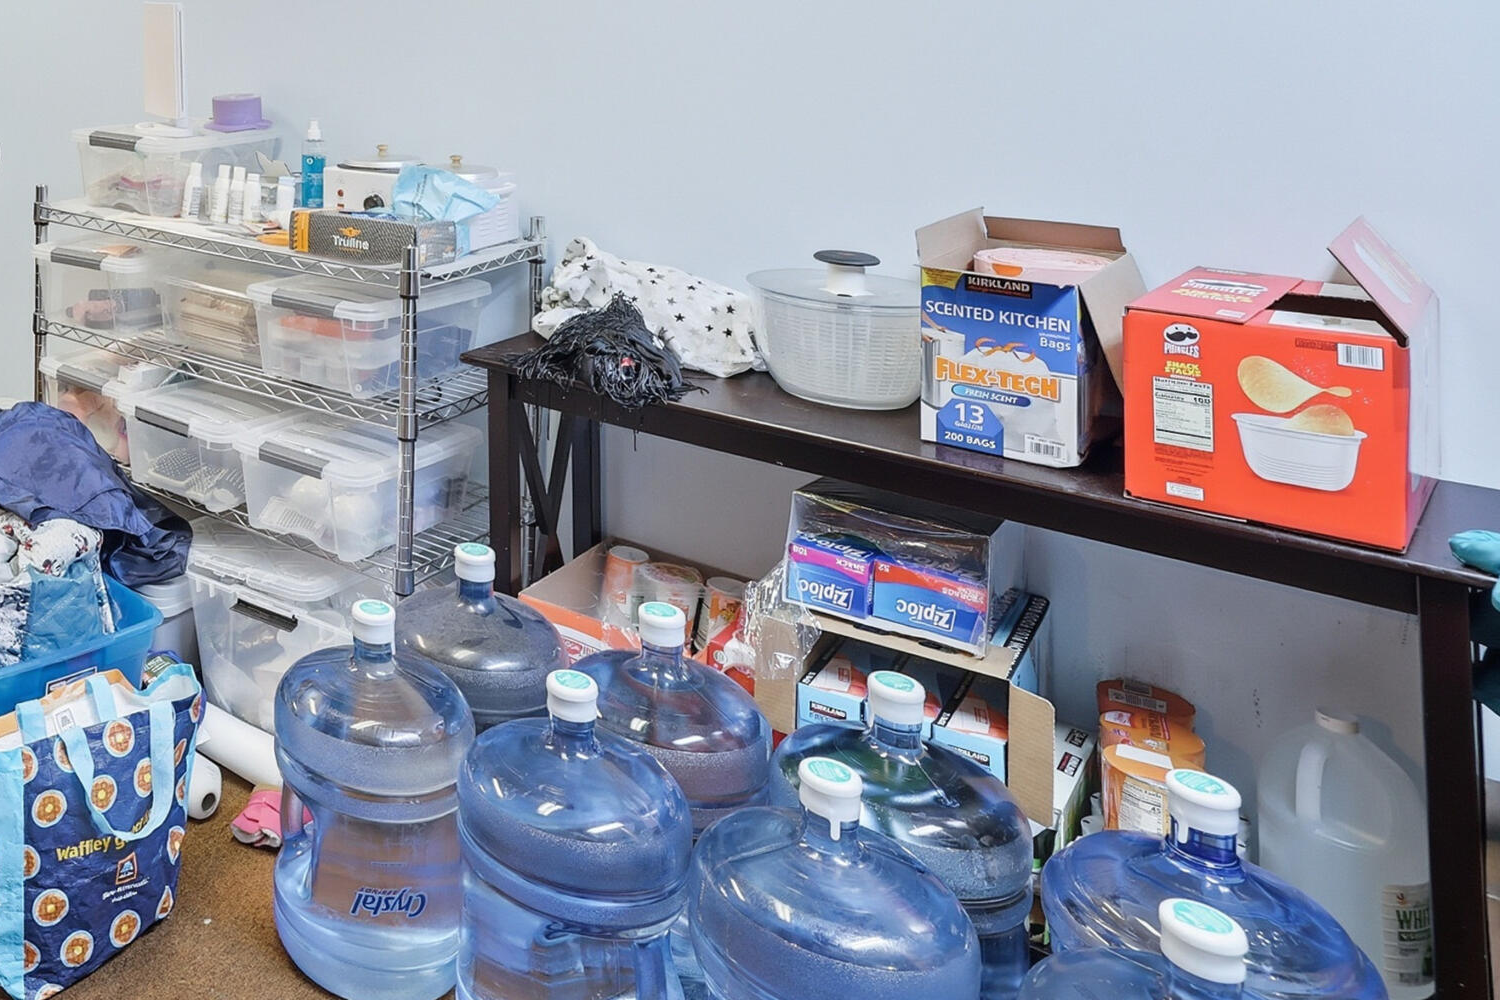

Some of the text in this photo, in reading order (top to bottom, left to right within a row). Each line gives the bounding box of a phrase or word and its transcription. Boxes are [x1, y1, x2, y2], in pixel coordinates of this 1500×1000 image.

[967, 276, 1031, 292] KIRKLAND
[924, 299, 1071, 333] SCENTED KITCHEN
[1039, 337, 1072, 352] Bags
[1164, 341, 1201, 358] PRINGLES
[935, 356, 1061, 403] FLEX-TECH
[990, 391, 1019, 405] SCENT
[954, 402, 985, 425] 13
[944, 430, 997, 450] 200 BAGS
[799, 578, 854, 609] Ziploc
[896, 599, 955, 632] Ziploc
[56, 836, 111, 861] Waffley
[351, 888, 427, 917] Crystal
